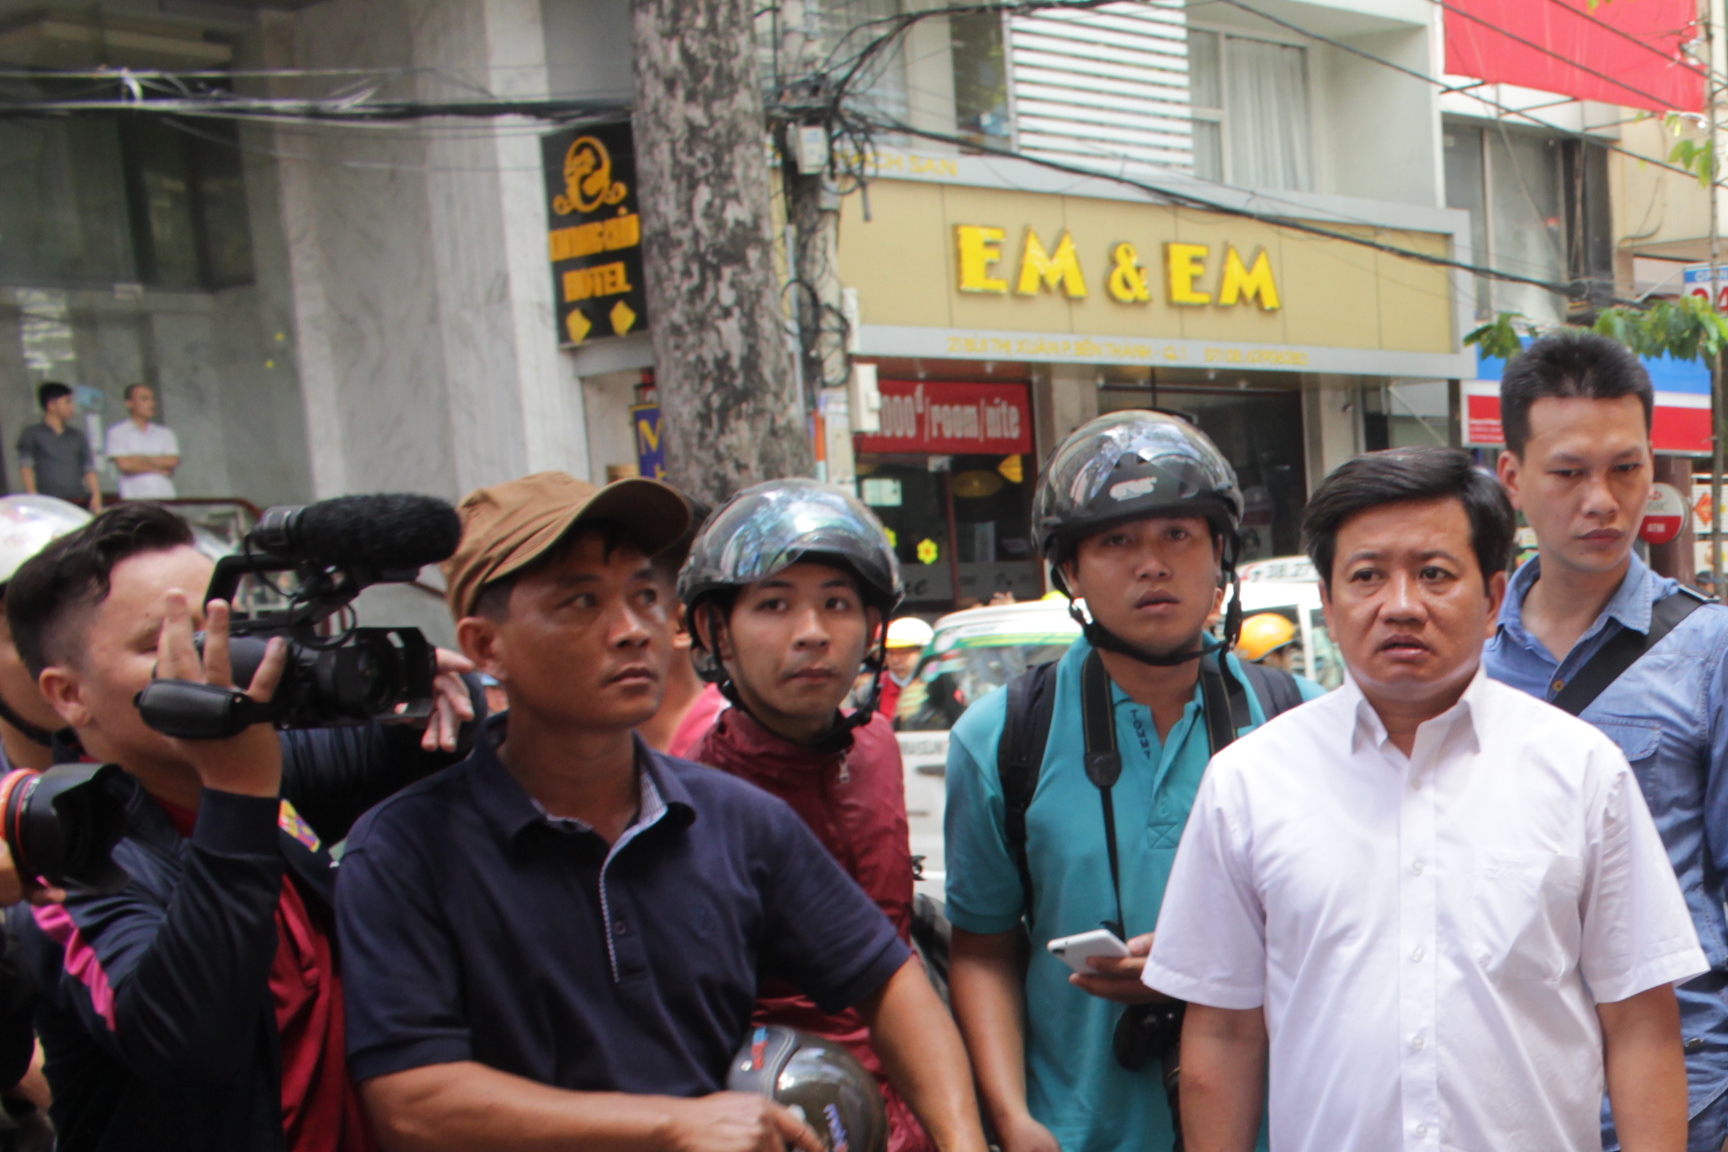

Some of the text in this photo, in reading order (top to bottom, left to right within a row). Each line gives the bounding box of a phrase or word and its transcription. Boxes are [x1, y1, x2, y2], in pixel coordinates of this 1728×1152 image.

[953, 224, 1283, 312] EM & EM
